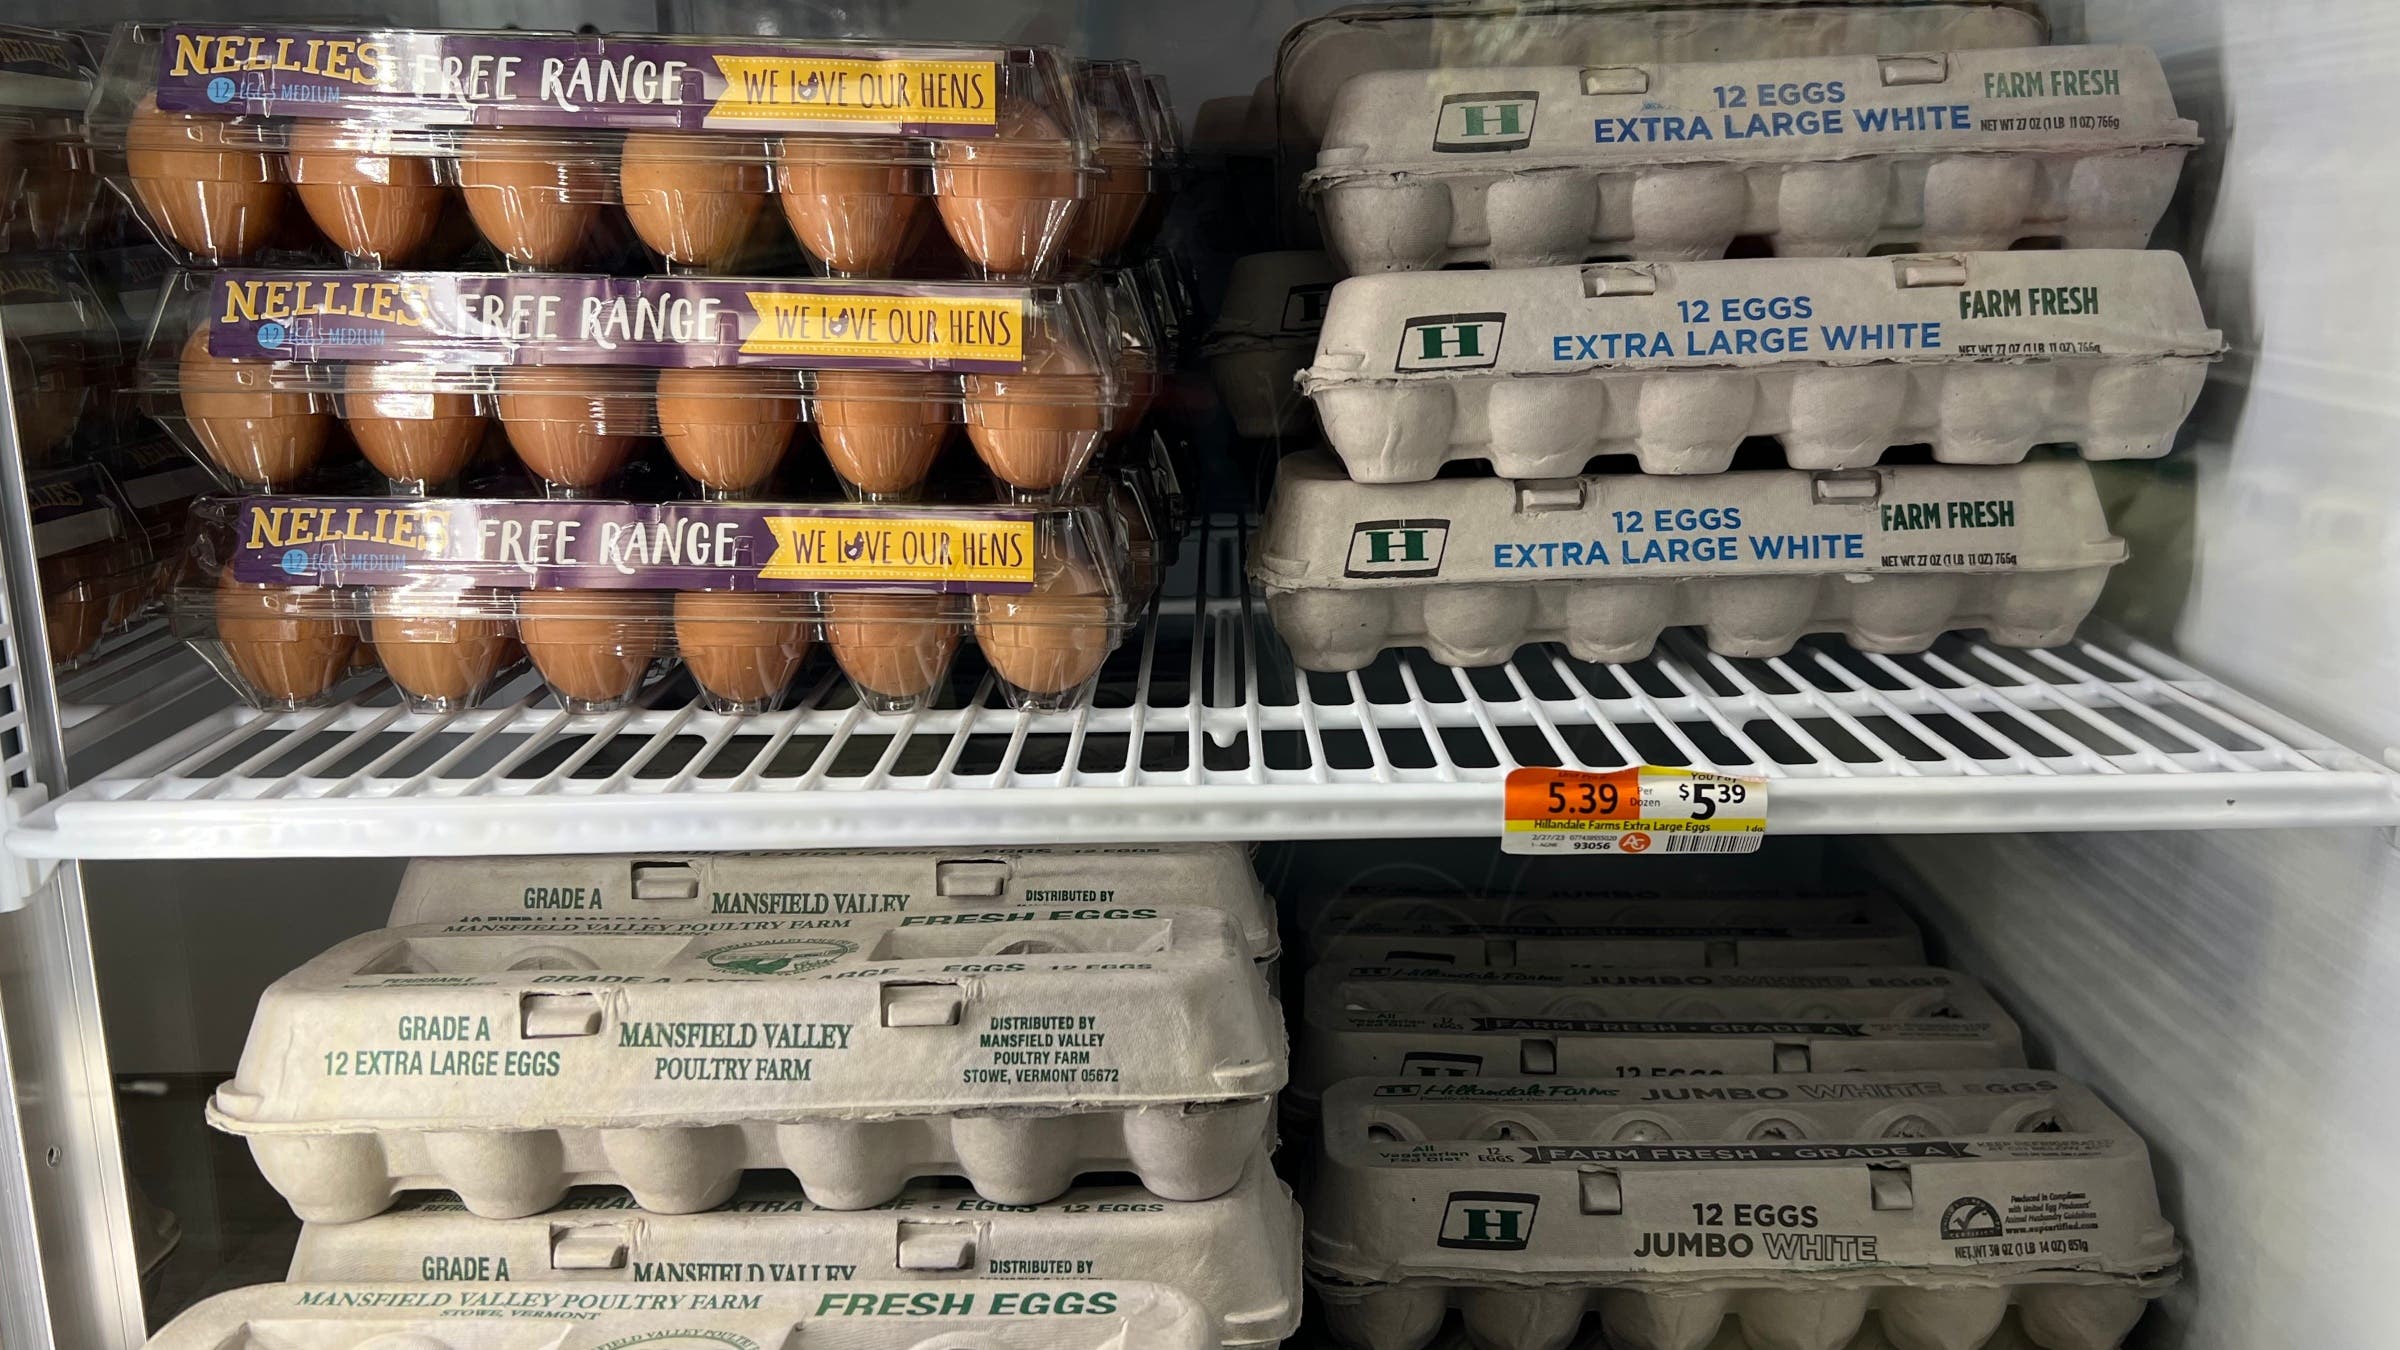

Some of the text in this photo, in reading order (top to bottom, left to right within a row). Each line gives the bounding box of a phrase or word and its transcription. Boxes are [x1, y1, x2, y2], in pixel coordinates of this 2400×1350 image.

[213, 82, 341, 105] 12 MEDIUM
[415, 54, 687, 112] FREE RANGE
[743, 72, 781, 106] WE
[859, 73, 911, 108] OUR
[920, 74, 985, 110] HENS
[1983, 69, 2120, 100] FARM FRESH
[1713, 81, 1846, 109] 12 EGGS
[1460, 104, 1525, 137] H
[1594, 104, 1972, 144] EXTRA LARGE WHITE
[1980, 118, 1997, 132] NET
[1999, 118, 2015, 131] WT
[2029, 117, 2042, 130] OZ
[1677, 296, 1813, 324] 12 EGGS
[1959, 286, 2099, 320] FARM FRESH
[457, 293, 722, 350] FREE RANGE
[774, 304, 811, 339] WE
[888, 308, 937, 342] OUR
[949, 309, 1011, 346] HENS
[329, 328, 385, 345] MEDIUM
[1417, 324, 1484, 360] H
[1553, 322, 1941, 361] EXTRA LARGE WHITE
[1612, 508, 1742, 534] 12 EGGS
[1881, 501, 2015, 531] FARM FRESH
[480, 518, 738, 575] FREE RANGE
[793, 529, 826, 563] WE
[902, 531, 952, 565] OUR
[963, 532, 1023, 567] HENS
[1366, 530, 1429, 563] H
[1493, 534, 1865, 568] EXTRA LARGE WHITE
[352, 553, 406, 571] MEDIUM
[1548, 782, 1619, 815] 5.39
[1637, 787, 1653, 795] Per
[1630, 797, 1661, 807] Dozen
[1534, 820, 1711, 834] Hillandale Farms Extra Large Eggs
[1573, 842, 1611, 850] 93056
[523, 887, 603, 910] GRADE A
[711, 892, 910, 915] MANSFIELD VALLEY
[1025, 889, 1115, 903] DISTRIBUTED BY
[443, 922, 579, 934] MANSFIELD
[586, 921, 679, 933] VALLEY
[680, 919, 783, 932] POULTRY
[790, 918, 853, 929] FARM
[900, 908, 1158, 927] FRESH EGGS
[942, 963, 1026, 972] EGGS
[1583, 976, 1713, 986] JUMBO
[399, 1015, 491, 1041] GRADE A
[990, 1016, 1095, 1031] DISTRIBUTED BY
[1495, 1019, 1805, 1034] FARM FRESH GRADE
[618, 1022, 855, 1050] MANSFIELD VALLEY
[980, 1032, 1105, 1048] MANSFIELD VALLEY
[324, 1050, 561, 1077] 12 EXTRA LARGE EGGS
[993, 1051, 1090, 1065] POULTRY FARM
[655, 1057, 812, 1081] POULTRY FARM
[963, 1068, 1119, 1085] STOWE, VERMONT 05672
[1424, 1083, 1620, 1097] Hillandale Farms
[1641, 1080, 2059, 1101] JUMBO WHITE EGGS
[1379, 1151, 1470, 1160] Vegetarian
[1412, 1145, 1435, 1153] All
[1477, 1154, 1515, 1164] EGGS
[1486, 1147, 1500, 1156] 12
[1549, 1145, 1949, 1161] FARM FRESH GRADE A
[1061, 1202, 1093, 1213] 12
[1096, 1202, 1164, 1213] EGGS
[2008, 1204, 2020, 1213] with
[2023, 1203, 2044, 1212] United
[2045, 1202, 2057, 1213] Egg
[2011, 1191, 2086, 1203] Produced Compliance
[1463, 1208, 1523, 1241] H
[1691, 1203, 1819, 1228] 12 EGGS
[2005, 1214, 2028, 1223] Animal
[1633, 1232, 1878, 1262] JUMBO WHITE
[422, 1256, 510, 1282] GRADE A
[633, 1262, 766, 1282] MANSFIELD
[989, 1259, 1095, 1275] DISTRIBUTED BY
[296, 1291, 764, 1311] MANSFIELD VALLEY POULTRY FARM
[814, 1291, 1118, 1317] FRESH EGGS
[510, 1309, 602, 1320] VERMONT
